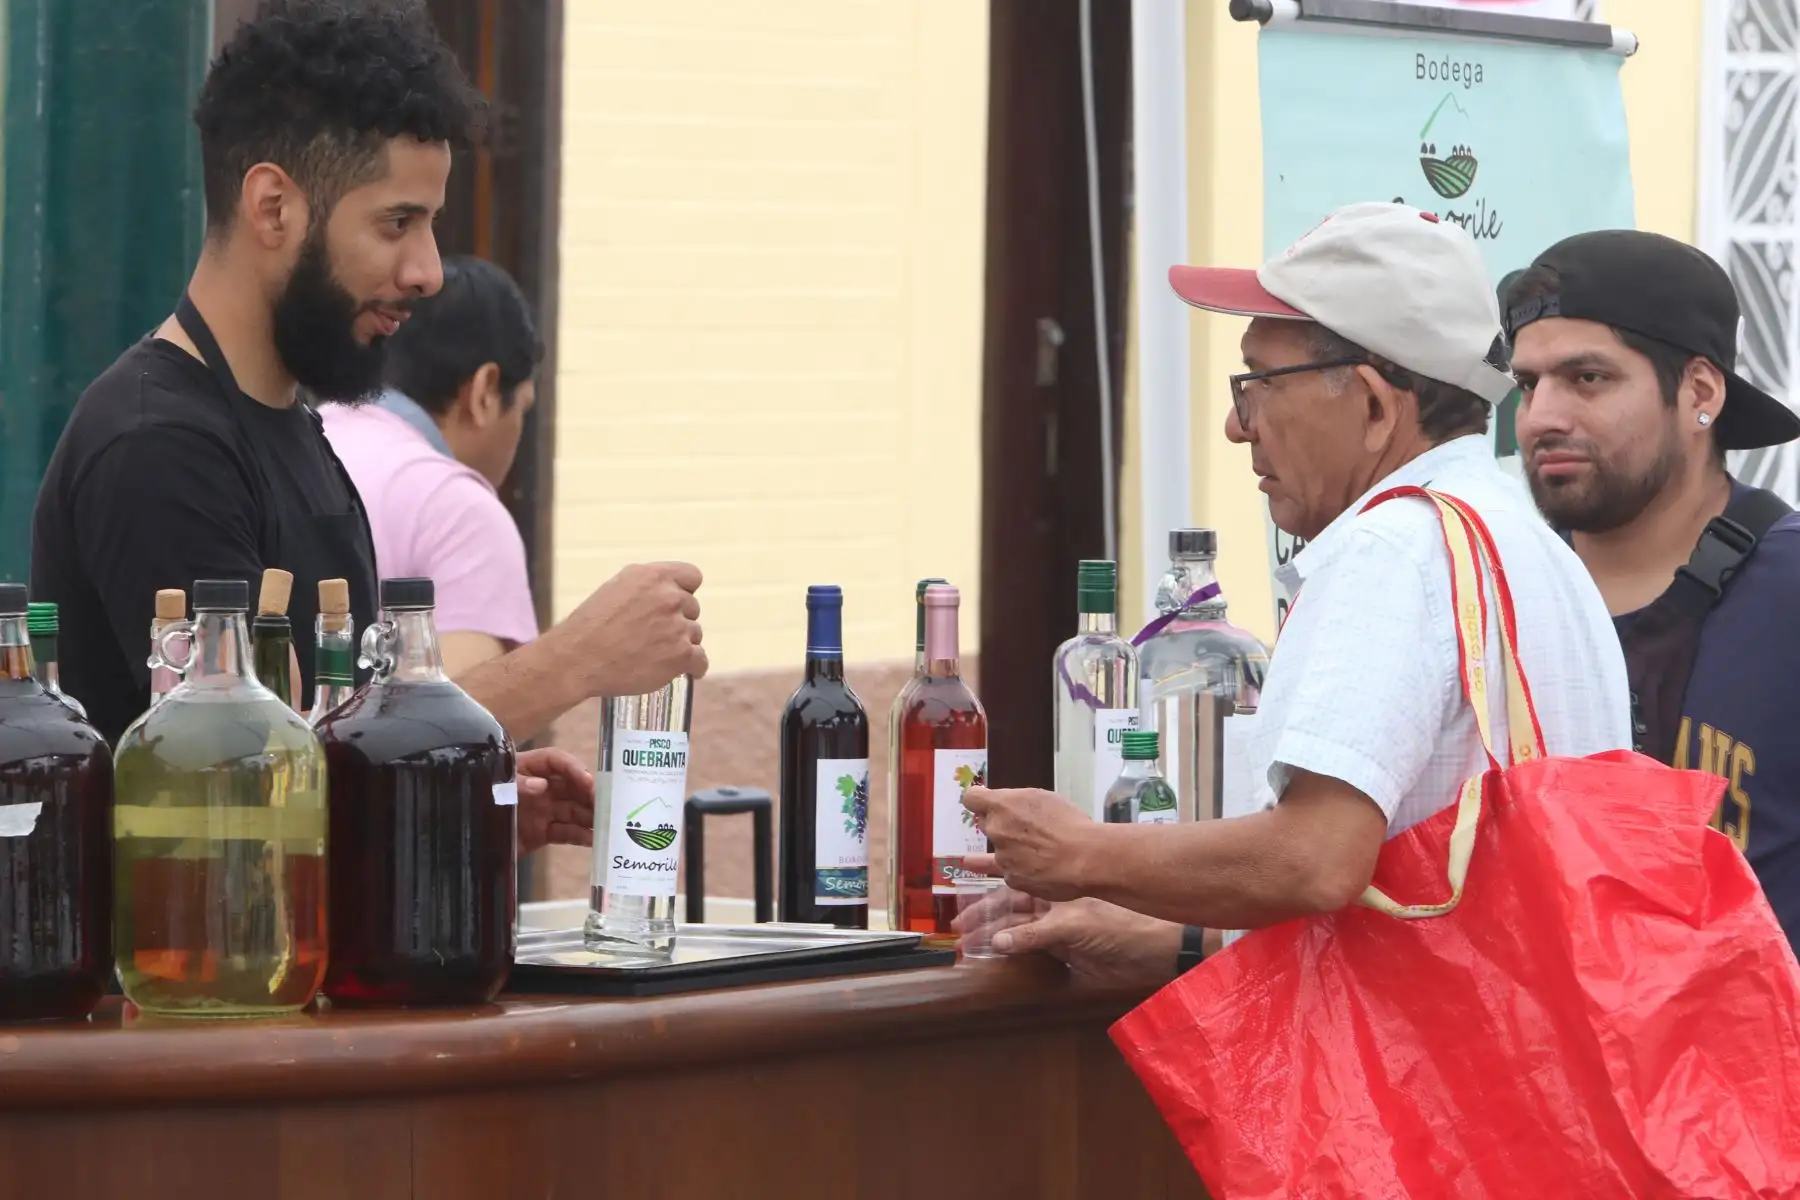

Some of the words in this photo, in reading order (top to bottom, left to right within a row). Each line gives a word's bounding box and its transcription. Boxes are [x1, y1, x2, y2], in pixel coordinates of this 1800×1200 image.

[1416, 53, 1483, 90] Bodega
[649, 738, 671, 749] PISCO
[622, 749, 686, 768] QUEBRANTA
